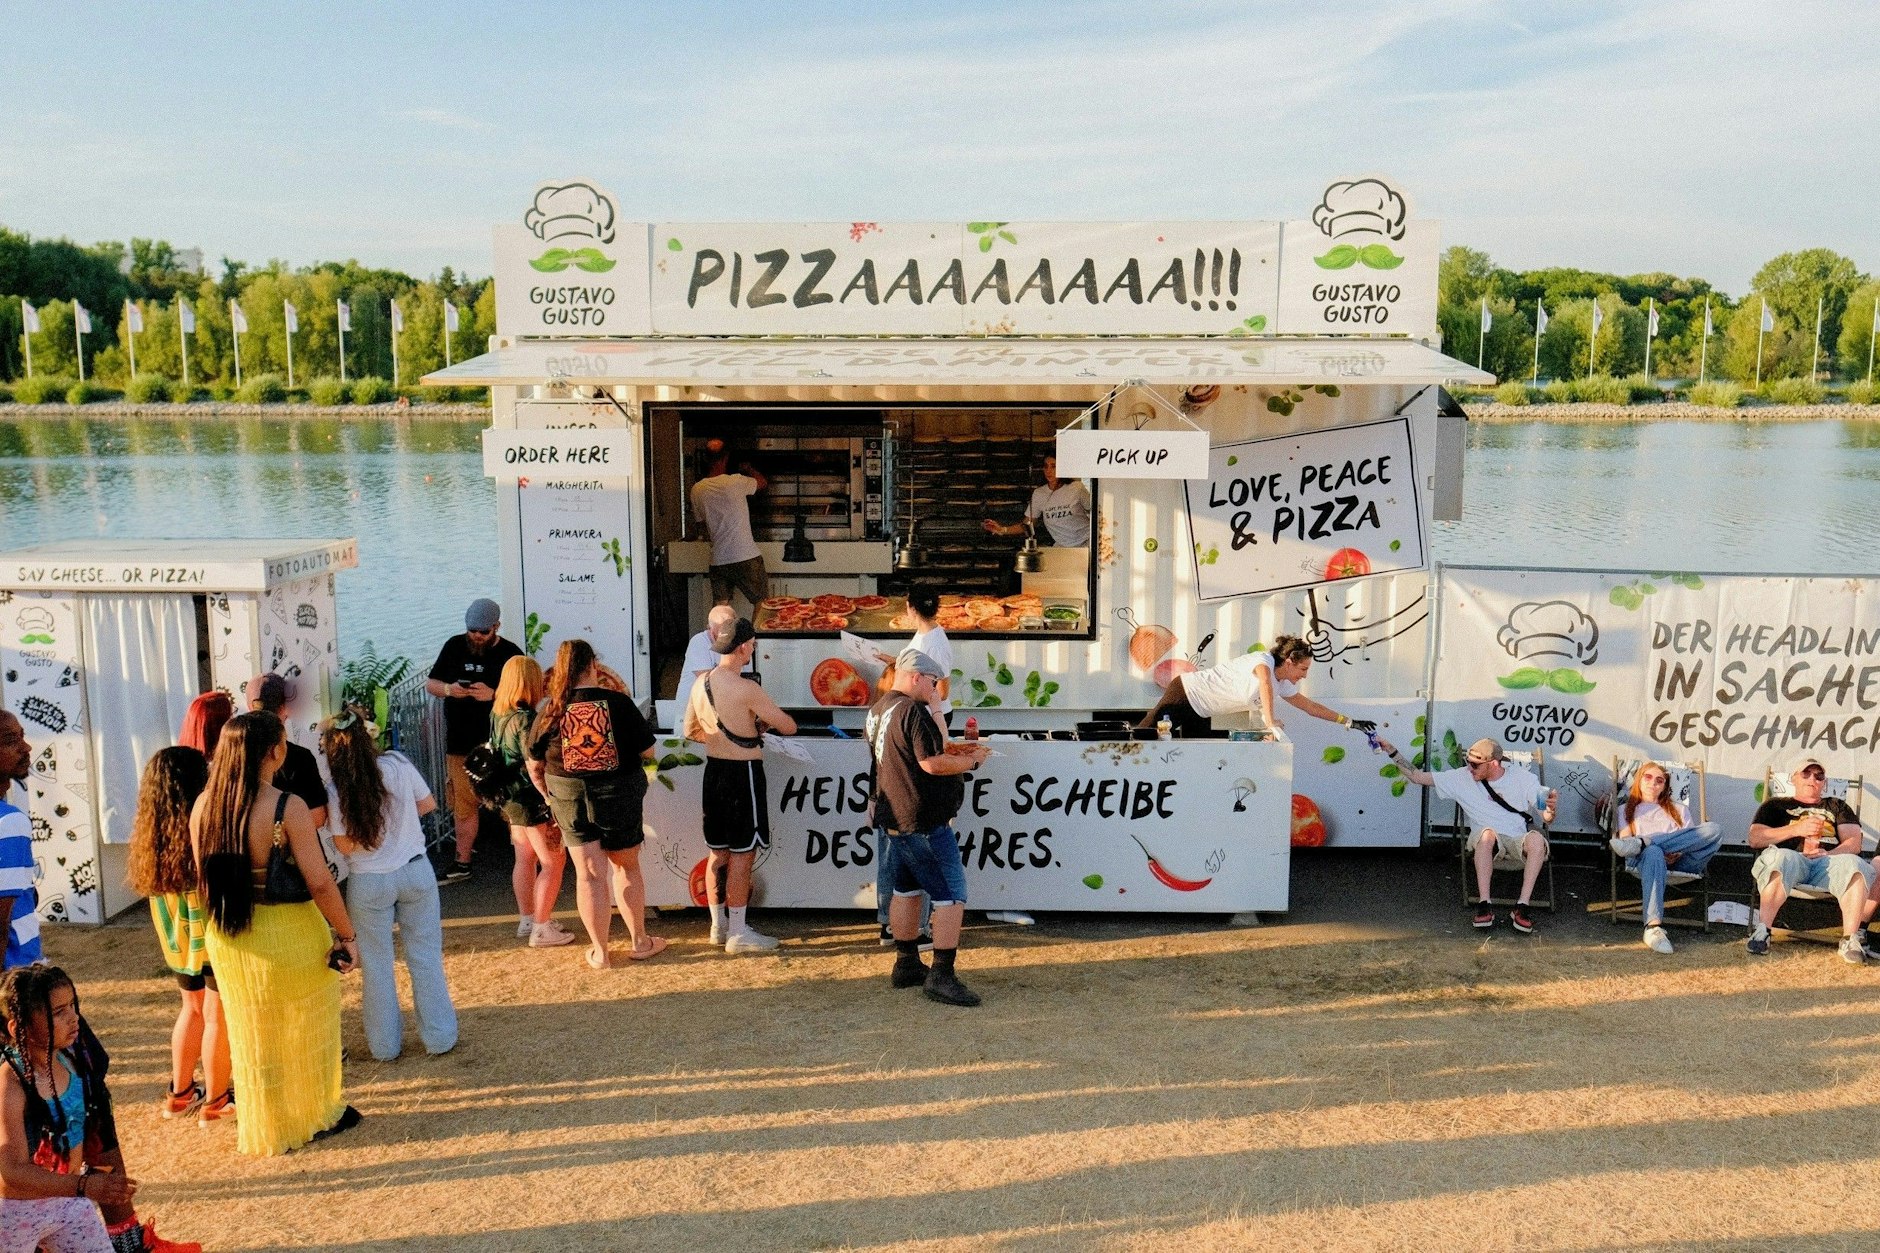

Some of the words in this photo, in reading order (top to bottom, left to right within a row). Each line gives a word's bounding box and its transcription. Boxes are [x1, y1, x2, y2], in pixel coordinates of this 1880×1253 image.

[687, 247, 1241, 311] PIZZAAAAAAAA!!!
[530, 286, 615, 305] GUSTAVO
[1312, 284, 1400, 303] GUSTAVO
[543, 307, 605, 326] GUSTO
[1324, 305, 1388, 324] GUSTO
[505, 446, 559, 464] ORDER
[566, 446, 610, 464] HERE
[1097, 448, 1140, 465] PICK
[1146, 449, 1168, 465] UP
[546, 480, 604, 491] MARGHERITA
[1209, 473, 1290, 508] LOVE,
[1300, 456, 1391, 495] PEACE
[1230, 511, 1258, 550] &
[1273, 495, 1380, 544] PIZZA
[549, 529, 603, 539] PRIMAVERA
[269, 547, 353, 579] FOTOAUTOMAT
[18, 567, 45, 582] SAY
[51, 567, 116, 583] CHEESE...
[123, 569, 143, 583] OR
[150, 568, 205, 584] PIZZA!
[559, 573, 595, 583] SALAME
[1652, 620, 1712, 654] DER
[1726, 624, 1880, 657] HEADLIN
[19, 650, 56, 659] GUSTAVO
[25, 659, 53, 668] GUSTO
[1654, 659, 1703, 702] IN
[1716, 661, 1880, 710] SACHE
[1492, 703, 1588, 727] GUSTAVO
[1504, 725, 1575, 747] GUSTO
[1010, 774, 1176, 820] SCHEIBE
[806, 826, 874, 868] DES
[955, 827, 1060, 871] HRES.
